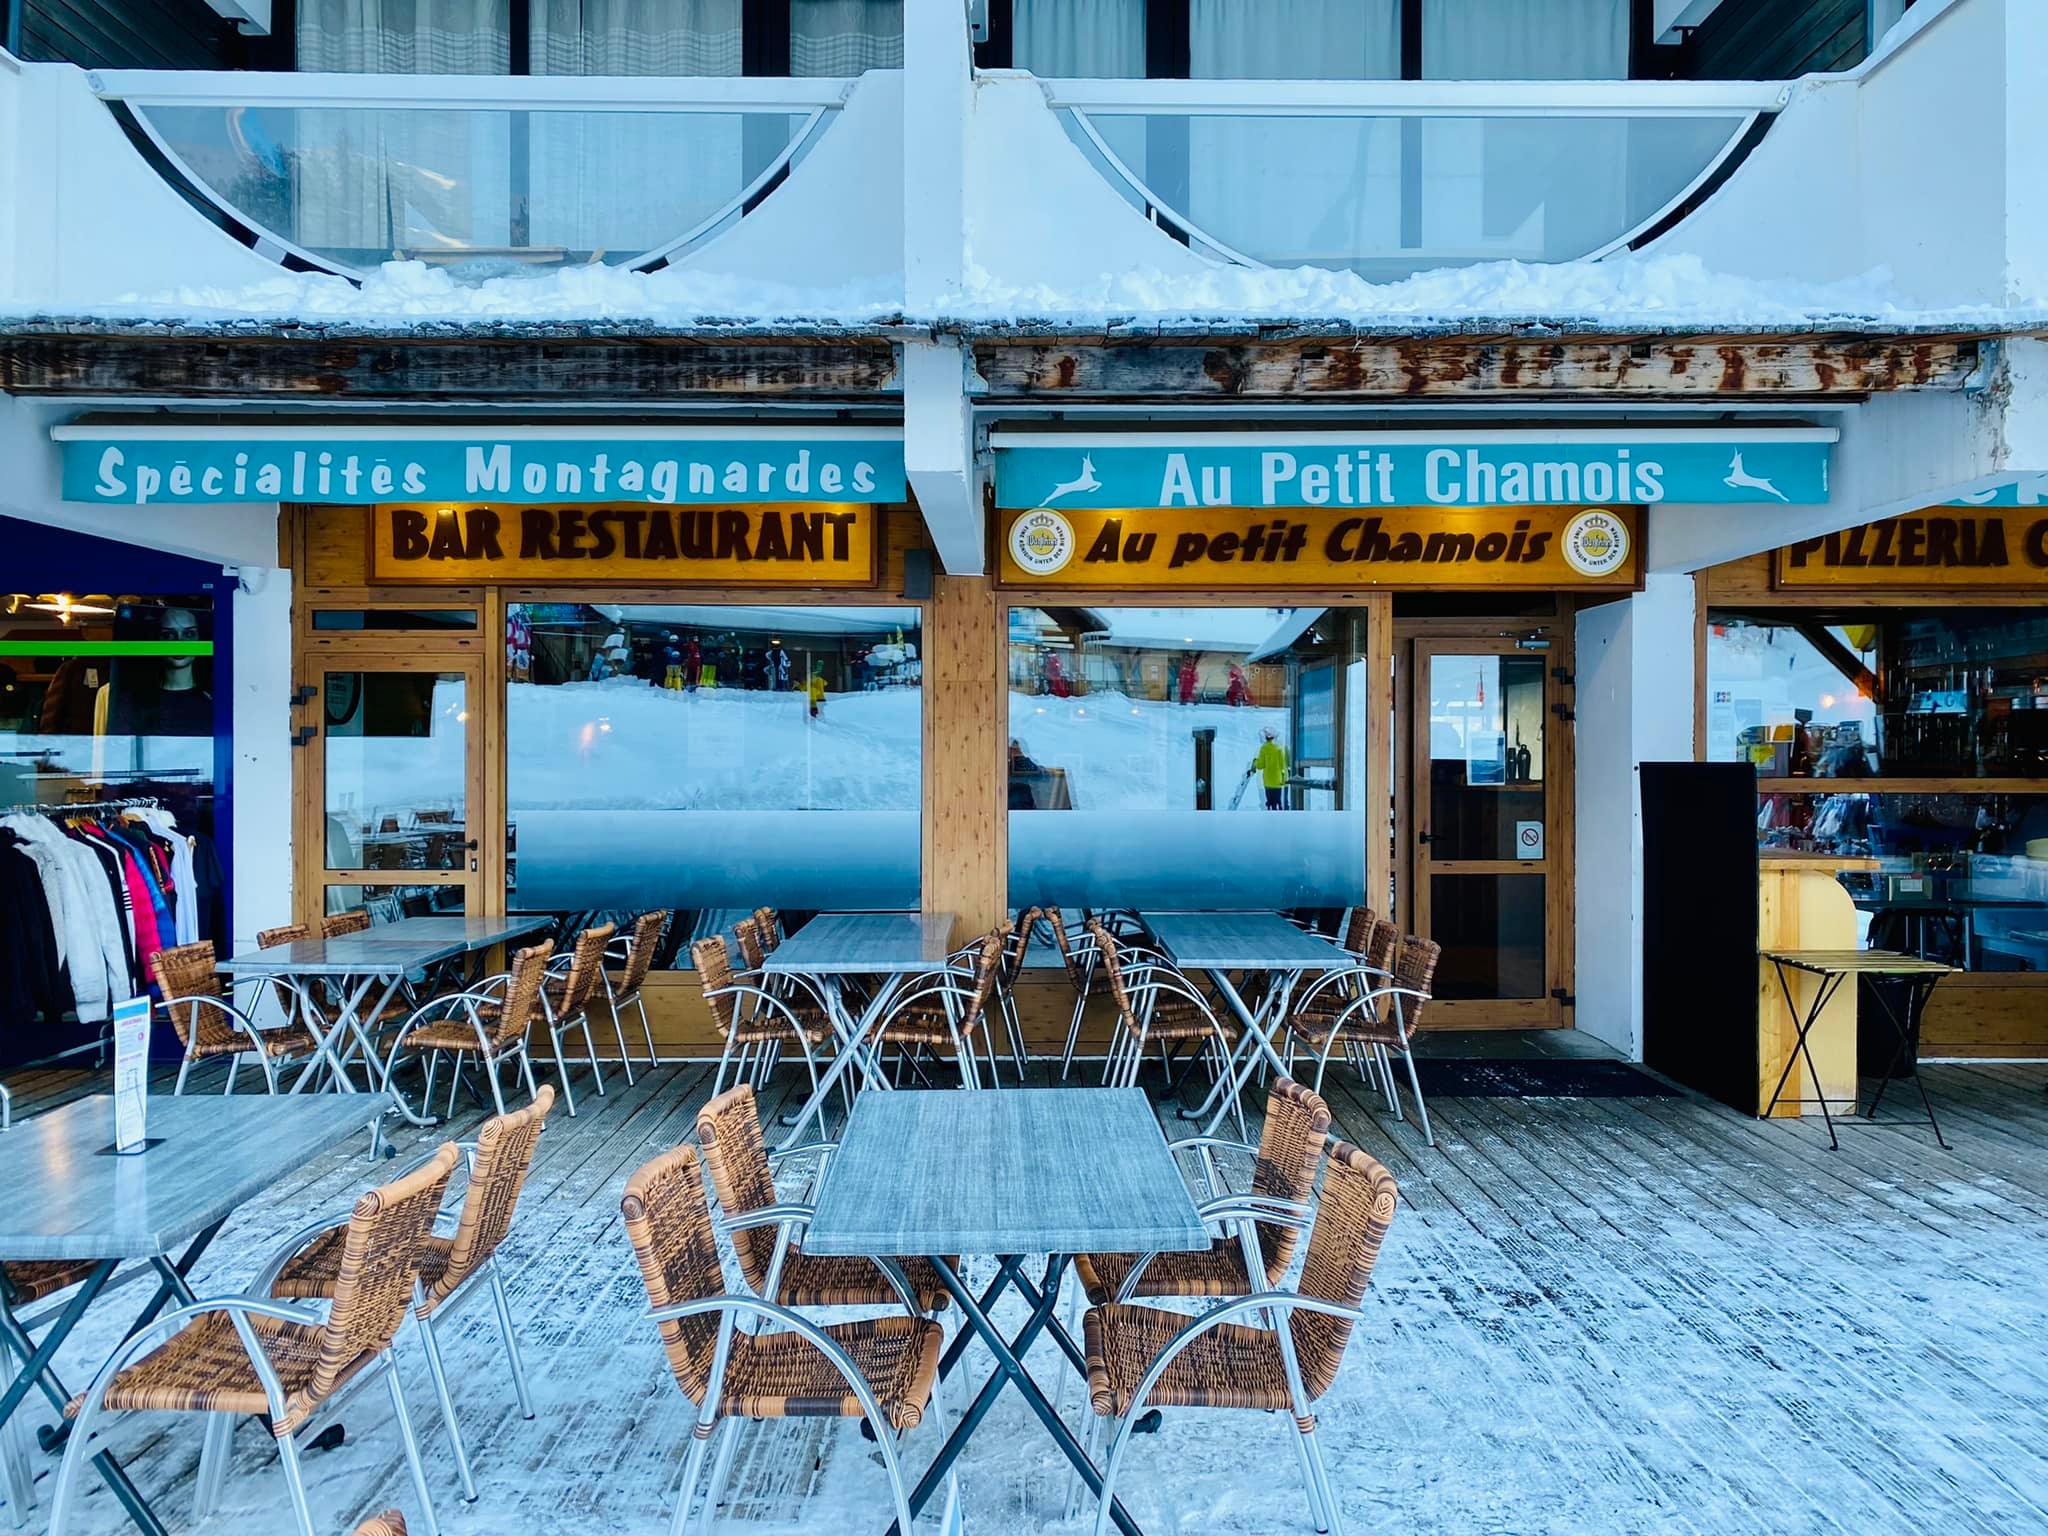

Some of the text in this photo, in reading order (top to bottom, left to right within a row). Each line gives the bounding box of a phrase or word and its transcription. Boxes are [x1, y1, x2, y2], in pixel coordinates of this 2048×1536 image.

[465, 444, 876, 503] Montagnardes
[1159, 448, 1665, 506] Au Petit Chamois
[391, 508, 857, 562] BAR RESTAURANT
[1083, 516, 1553, 569] Au petit Chamois
